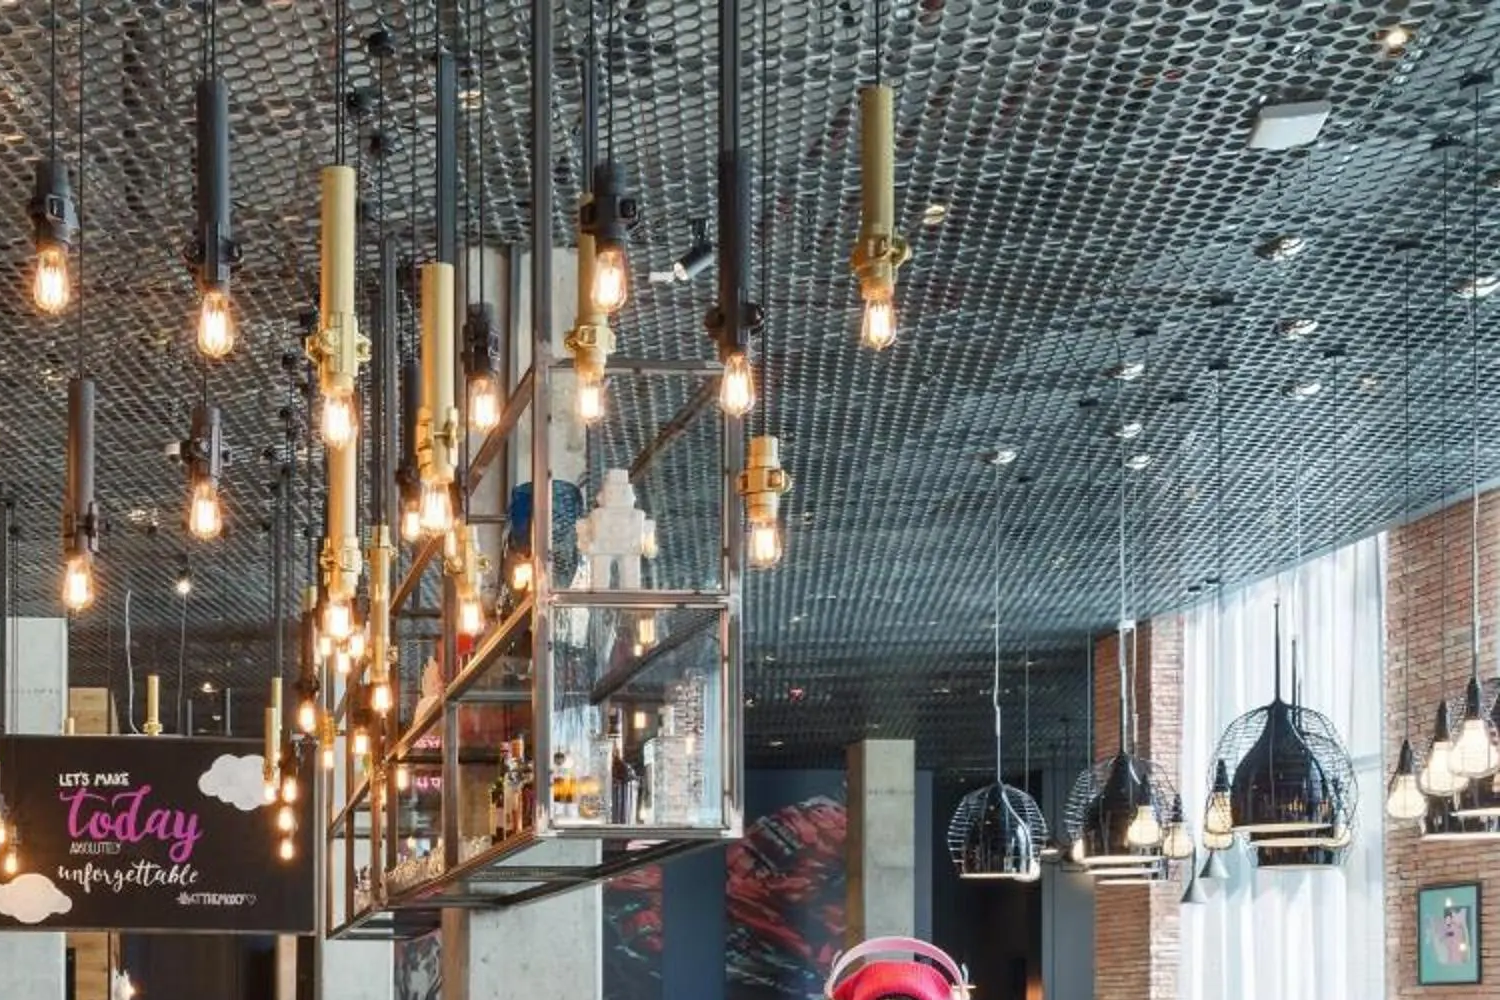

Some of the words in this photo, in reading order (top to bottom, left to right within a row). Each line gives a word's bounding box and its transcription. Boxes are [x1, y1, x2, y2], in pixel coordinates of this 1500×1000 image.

[58, 772, 89, 787] LET'S
[94, 772, 130, 787] MAKE
[60, 784, 202, 863] today
[57, 860, 199, 893] unforgettable
